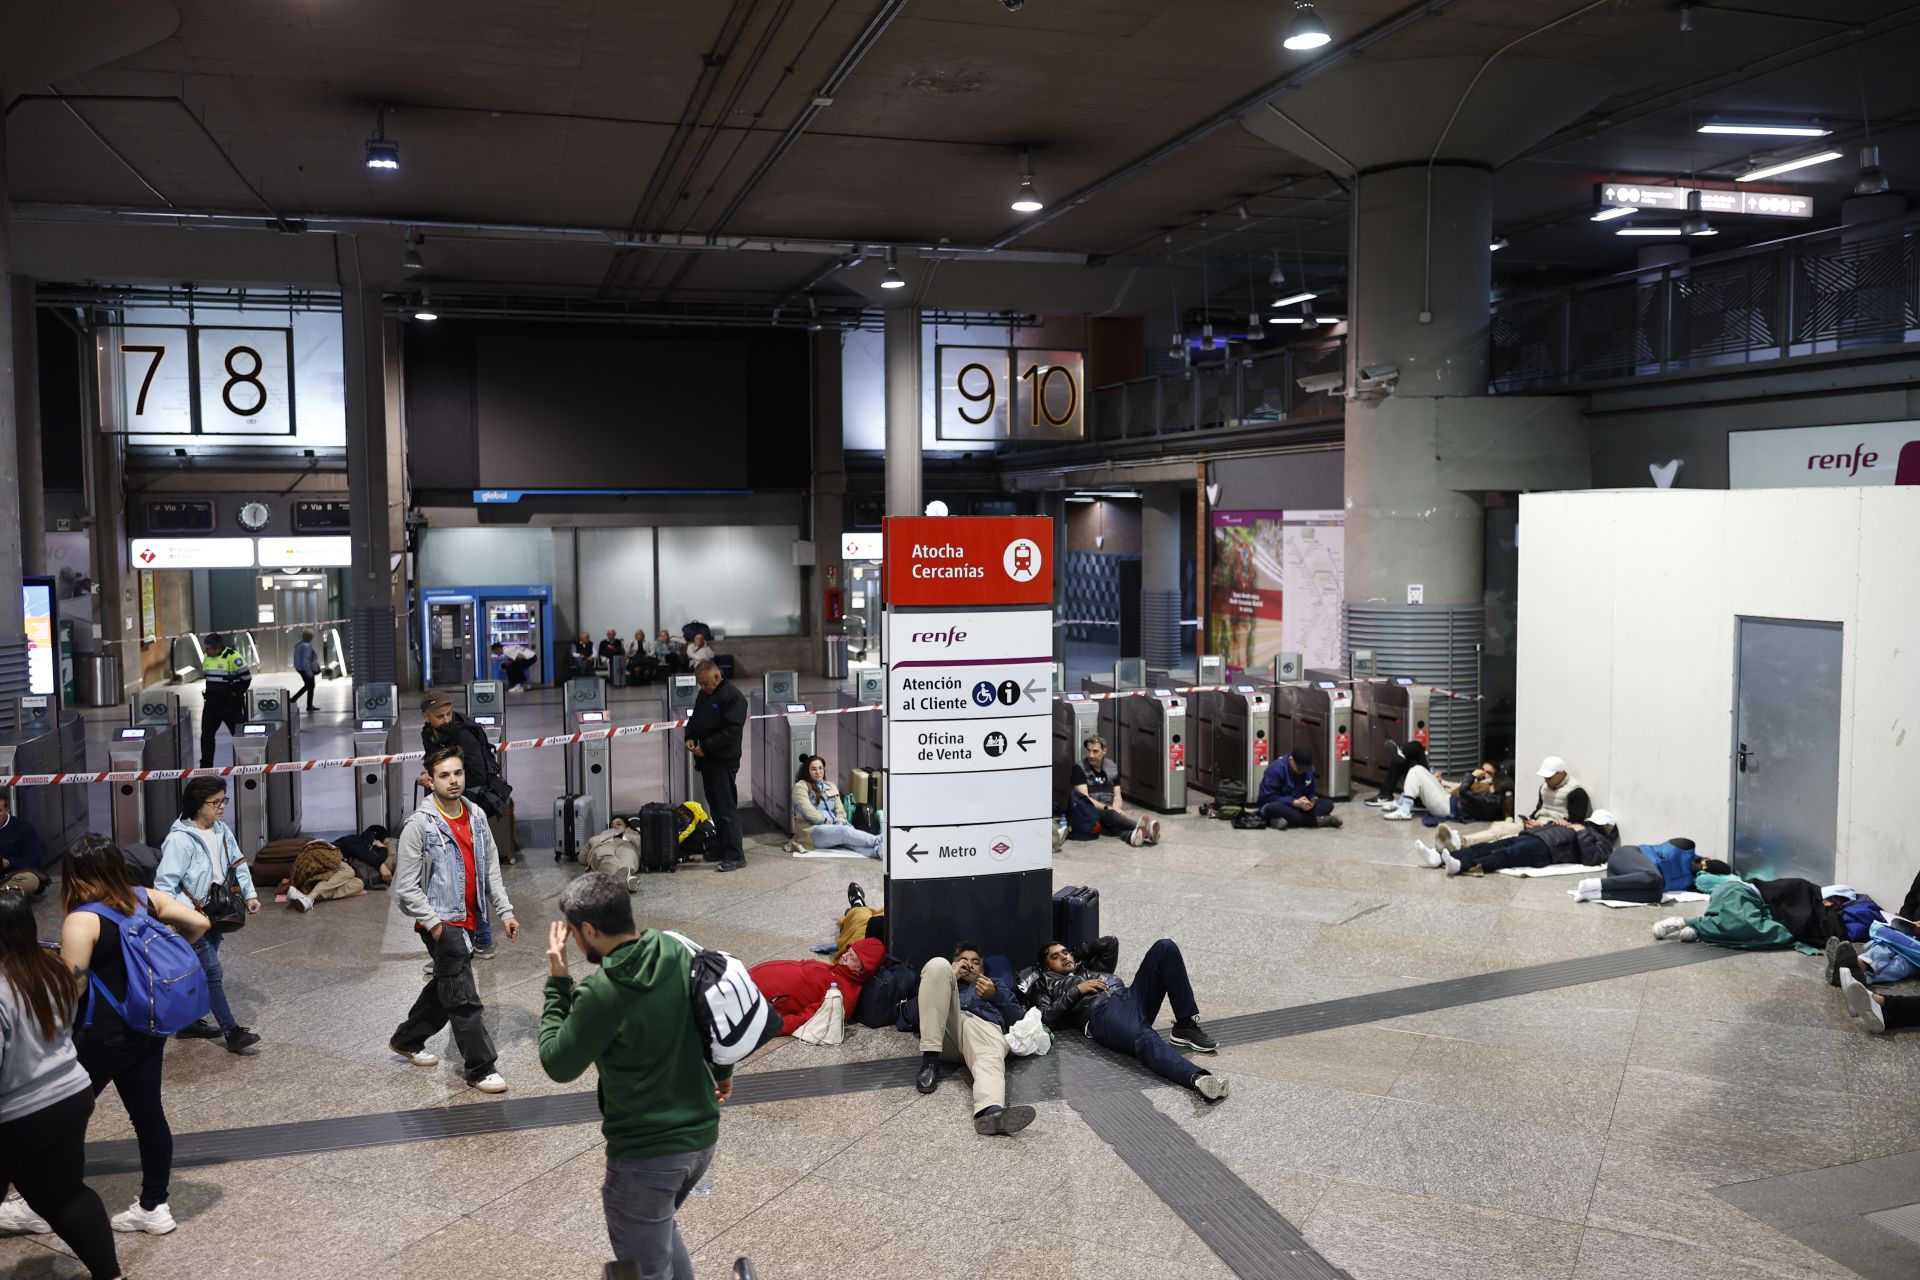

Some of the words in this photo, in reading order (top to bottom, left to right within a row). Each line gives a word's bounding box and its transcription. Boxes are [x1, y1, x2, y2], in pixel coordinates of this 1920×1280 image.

[120, 345, 165, 416] 7
[221, 345, 268, 417] 8
[957, 363, 996, 425] 9
[1022, 364, 1078, 427] 10
[1807, 442, 1879, 477] renfe
[481, 491, 508, 503] global
[144, 550, 152, 562] 7
[911, 543, 965, 560] Atocha
[911, 562, 985, 580] Cercanías
[911, 625, 968, 648] renfe
[902, 675, 963, 691] Atención
[902, 697, 916, 711] al
[920, 695, 968, 711] Cliente
[917, 732, 964, 747] Oficina
[917, 748, 934, 761] de
[936, 747, 972, 761] Venta
[66, 774, 94, 784] renfe
[938, 844, 977, 859] Metro
